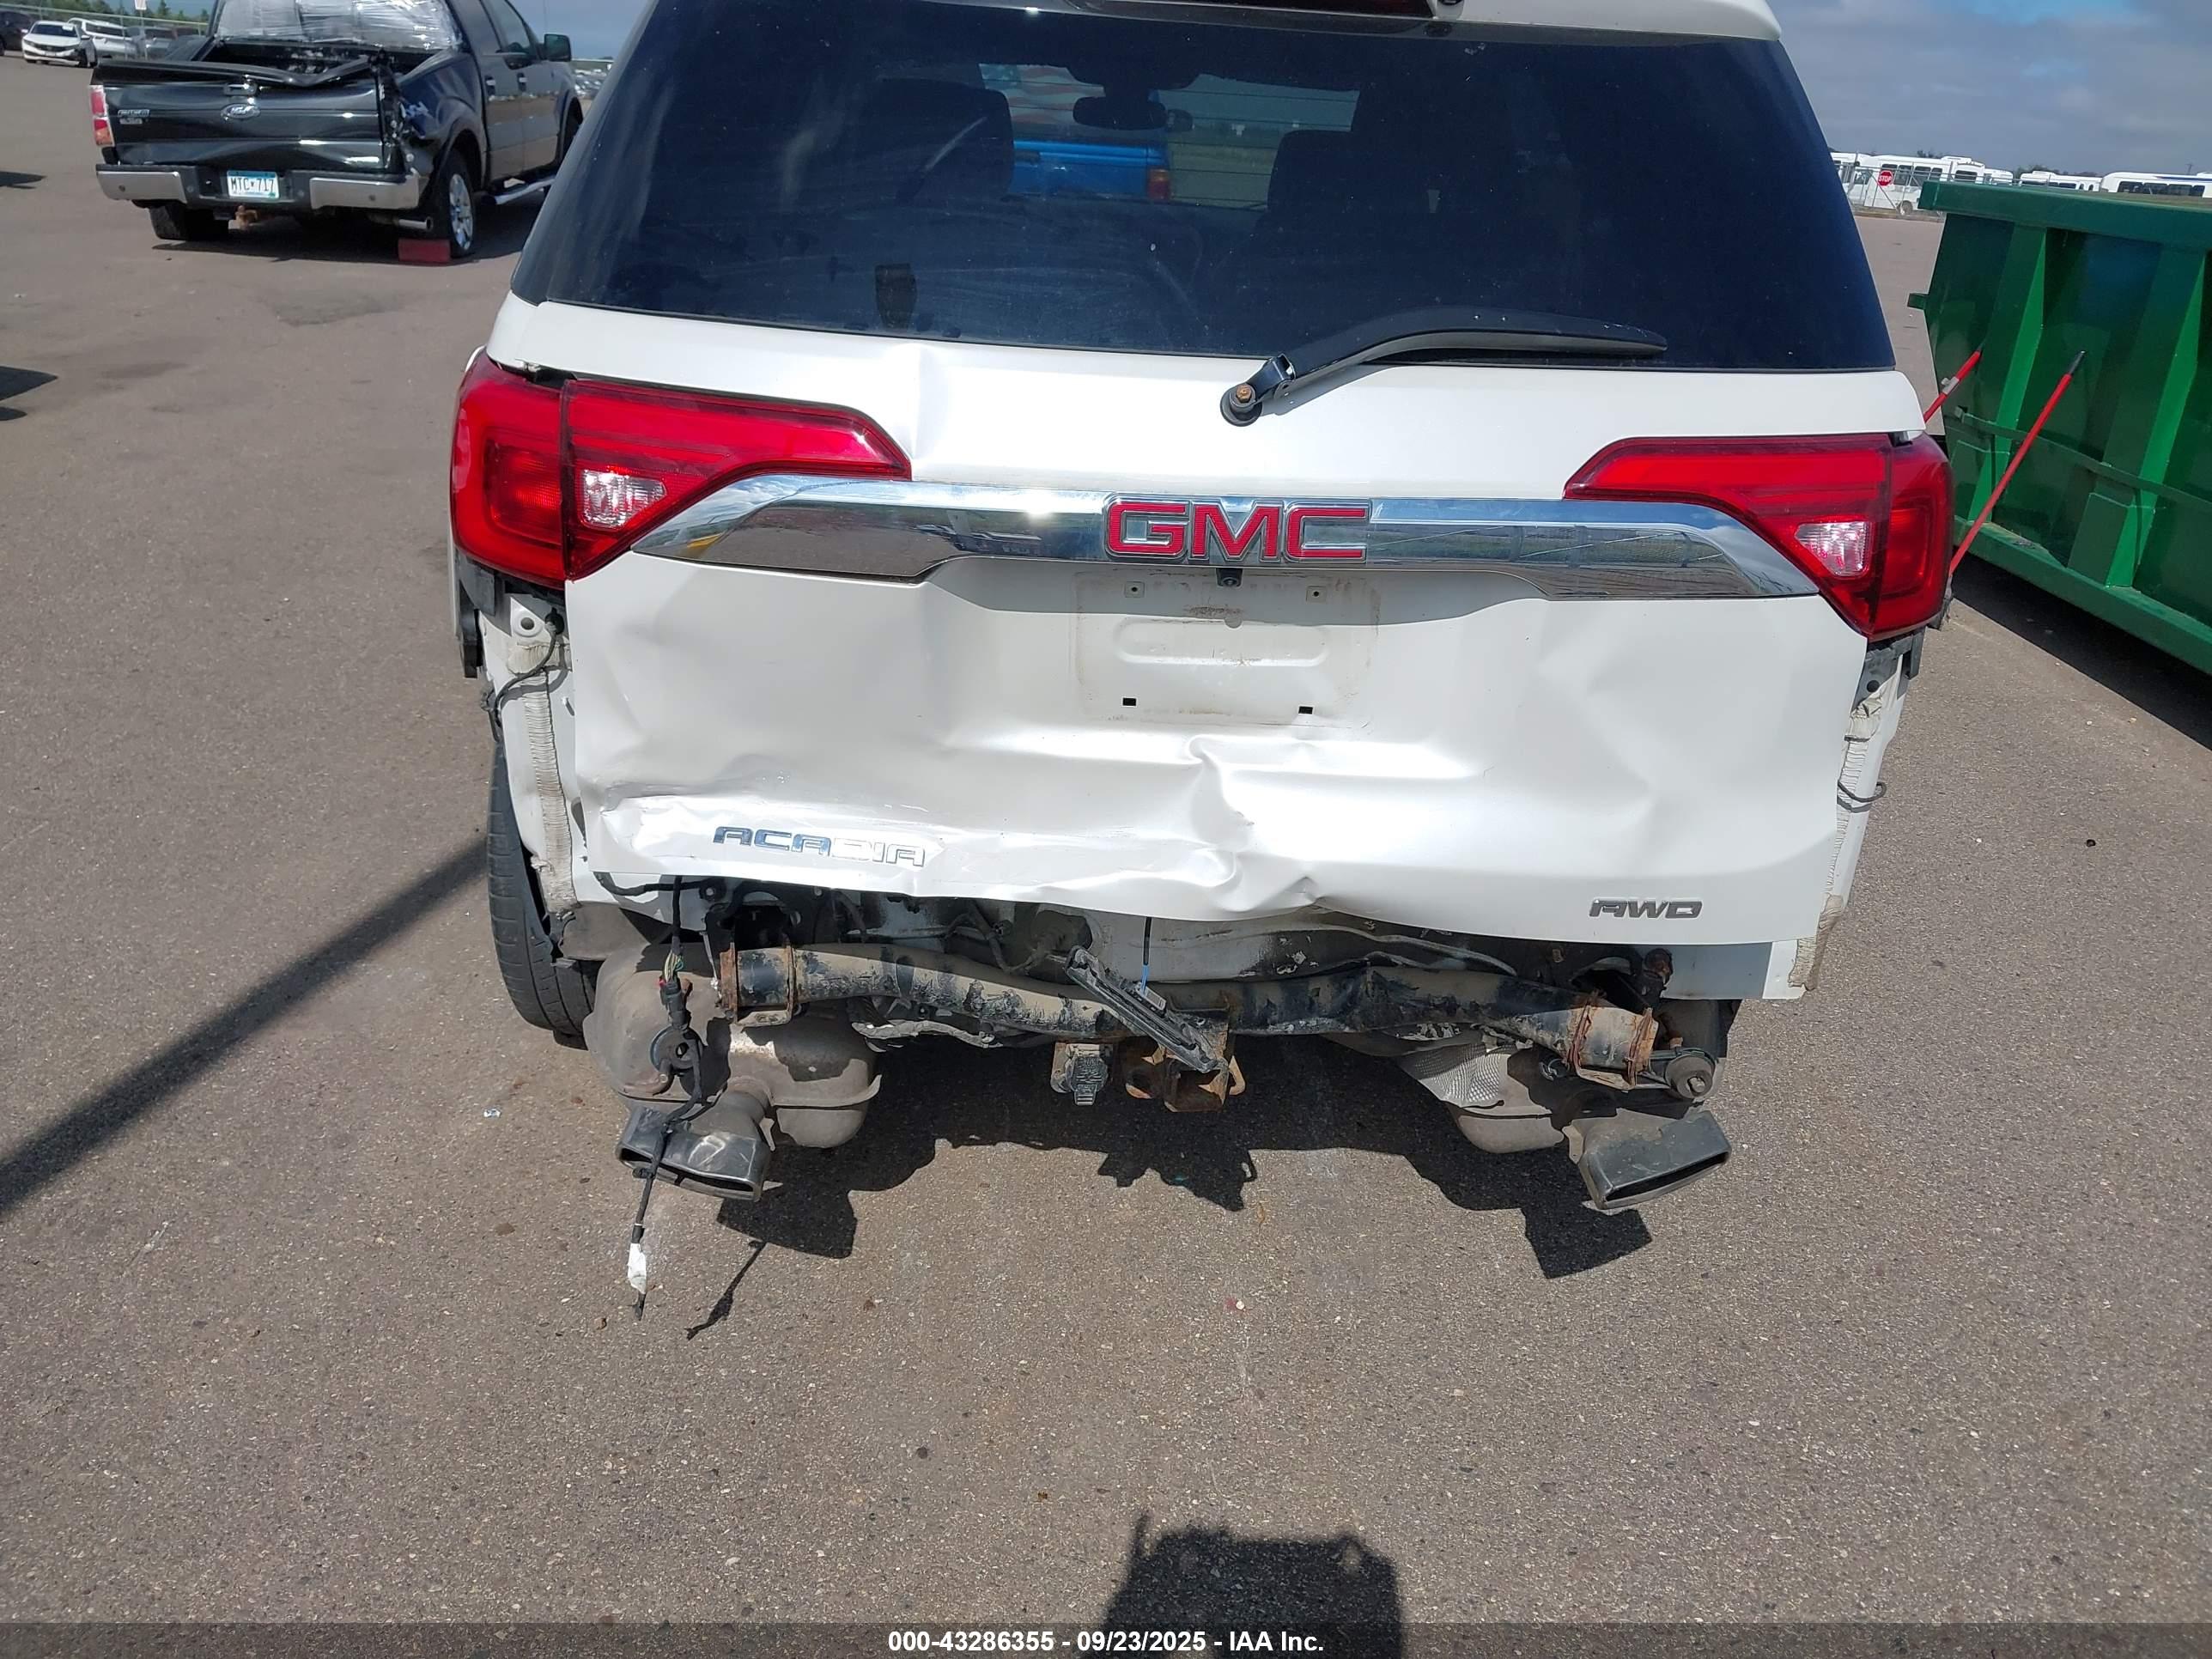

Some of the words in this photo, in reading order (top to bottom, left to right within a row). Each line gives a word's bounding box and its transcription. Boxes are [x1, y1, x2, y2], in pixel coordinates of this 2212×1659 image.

[1105, 497, 1369, 561] GMC
[713, 826, 926, 867] ACADIA
[1589, 899, 1703, 919] AWD
